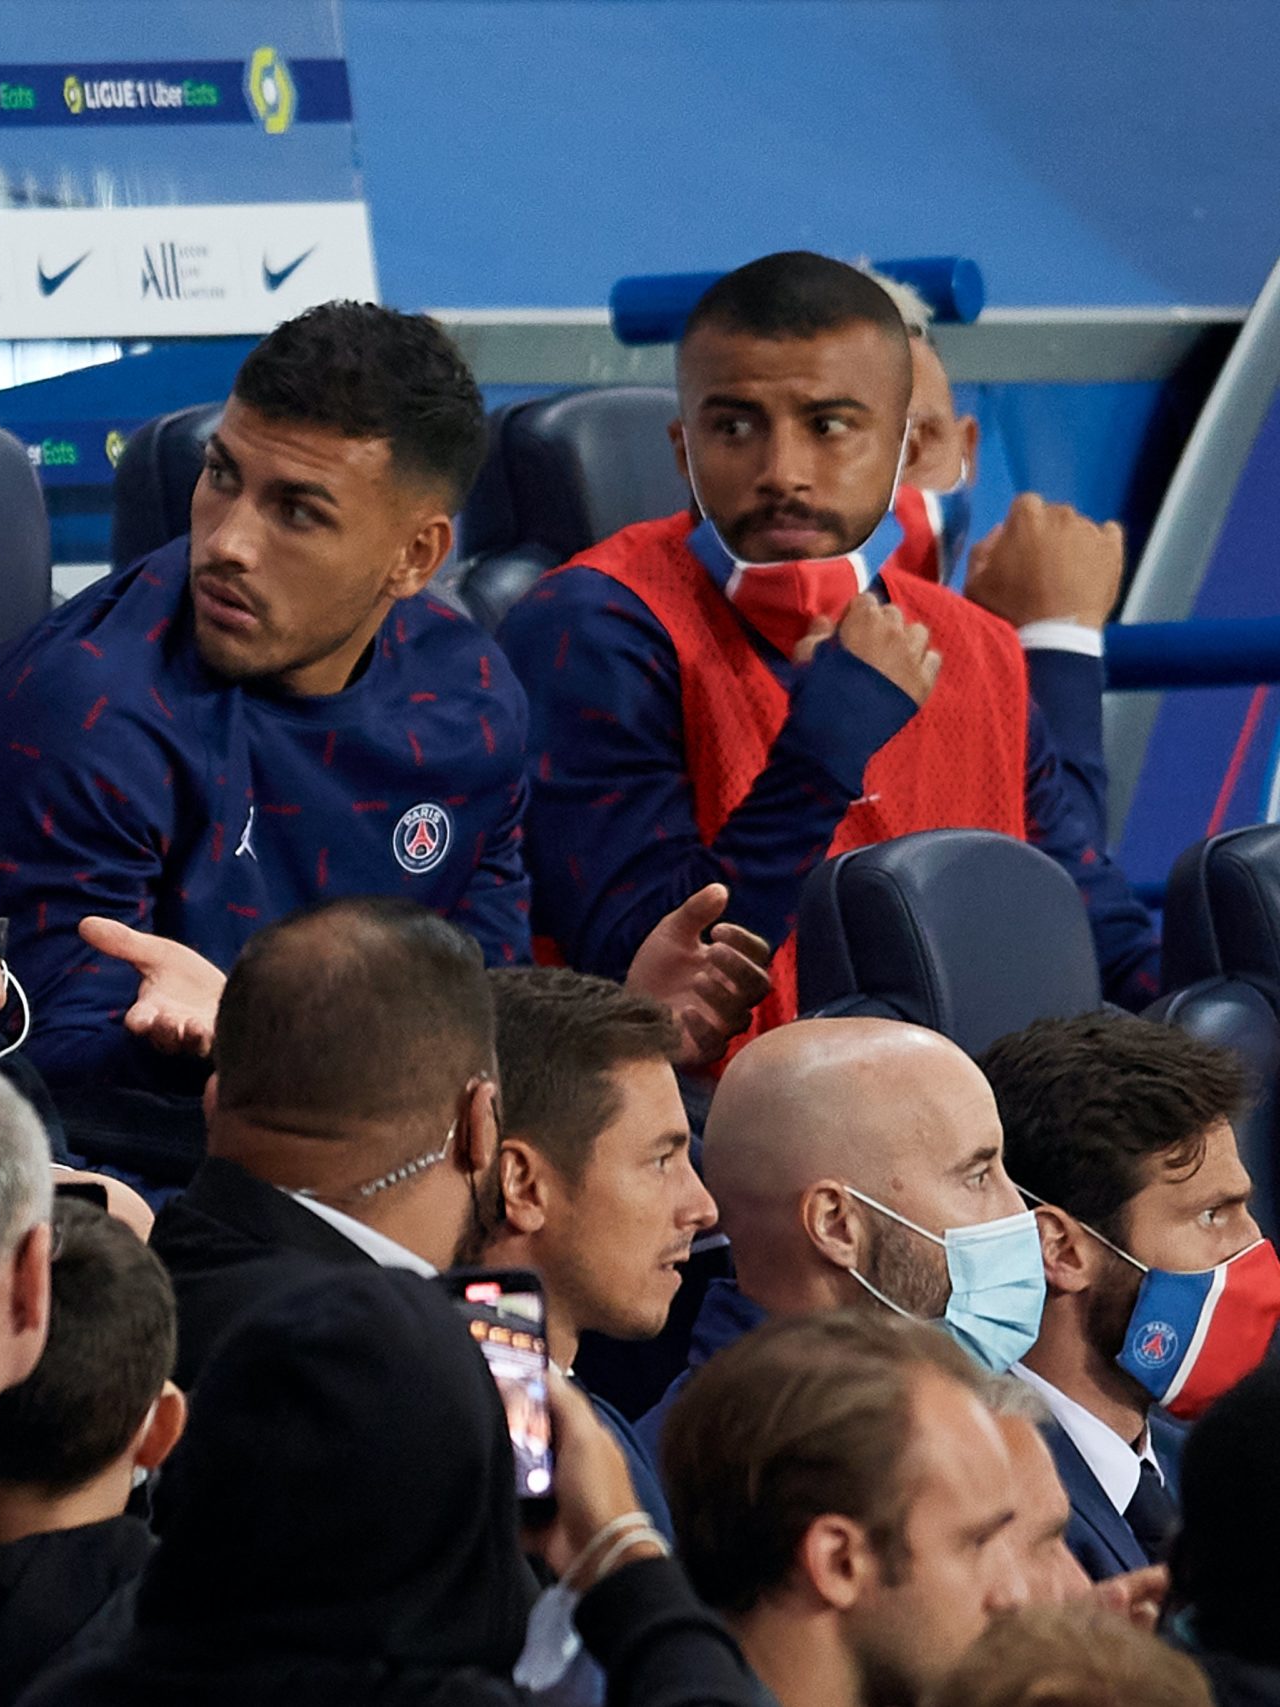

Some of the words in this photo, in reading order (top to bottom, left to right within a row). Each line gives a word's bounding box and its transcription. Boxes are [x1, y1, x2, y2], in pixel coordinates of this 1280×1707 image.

[84, 81, 136, 108] LIGUE
[137, 81, 146, 107] 1
[403, 807, 442, 826] PARIS
